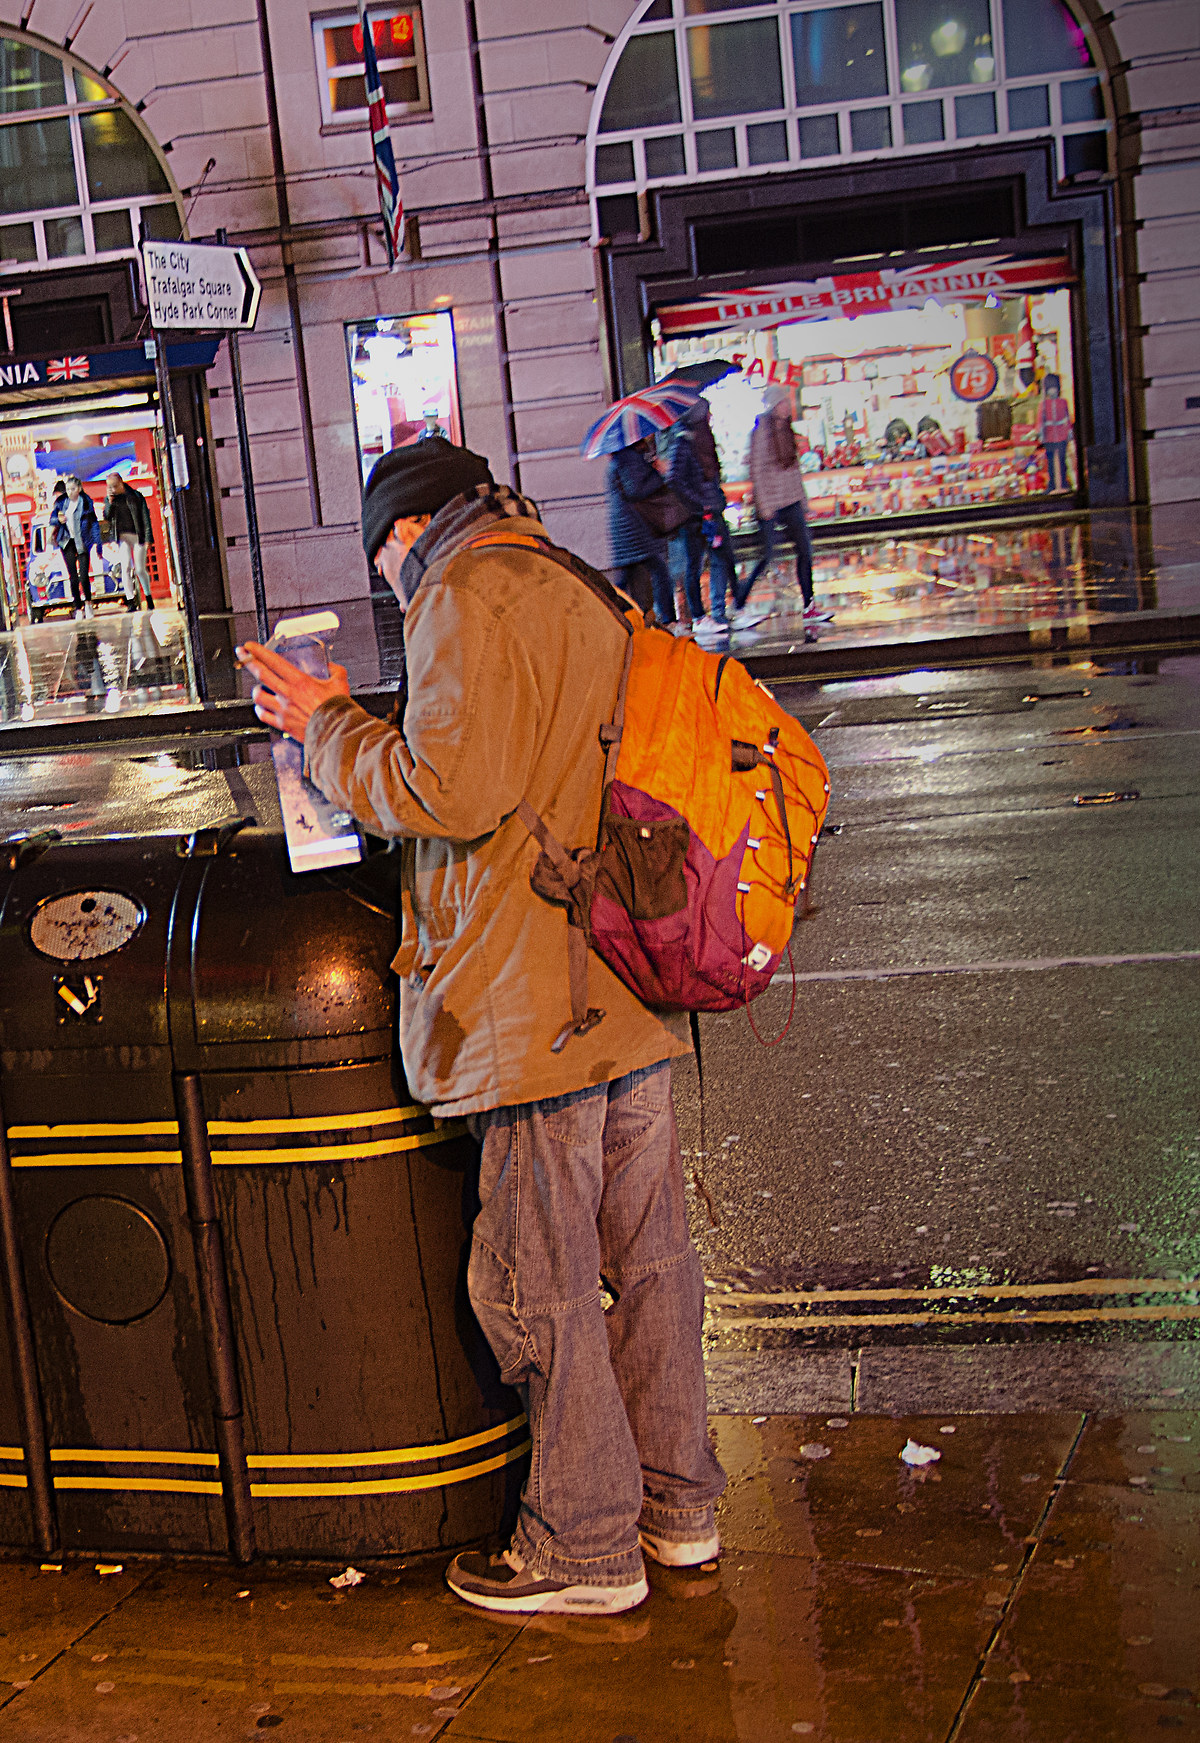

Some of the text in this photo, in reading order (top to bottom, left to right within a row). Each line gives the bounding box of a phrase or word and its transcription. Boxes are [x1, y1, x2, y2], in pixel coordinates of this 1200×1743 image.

[148, 251, 189, 273] The City
[151, 276, 231, 298] Trafalgar Square
[717, 270, 1005, 320] LITTLE BRITANNIA
[153, 301, 237, 322] Hyde Park Corner
[957, 363, 987, 389] 75
